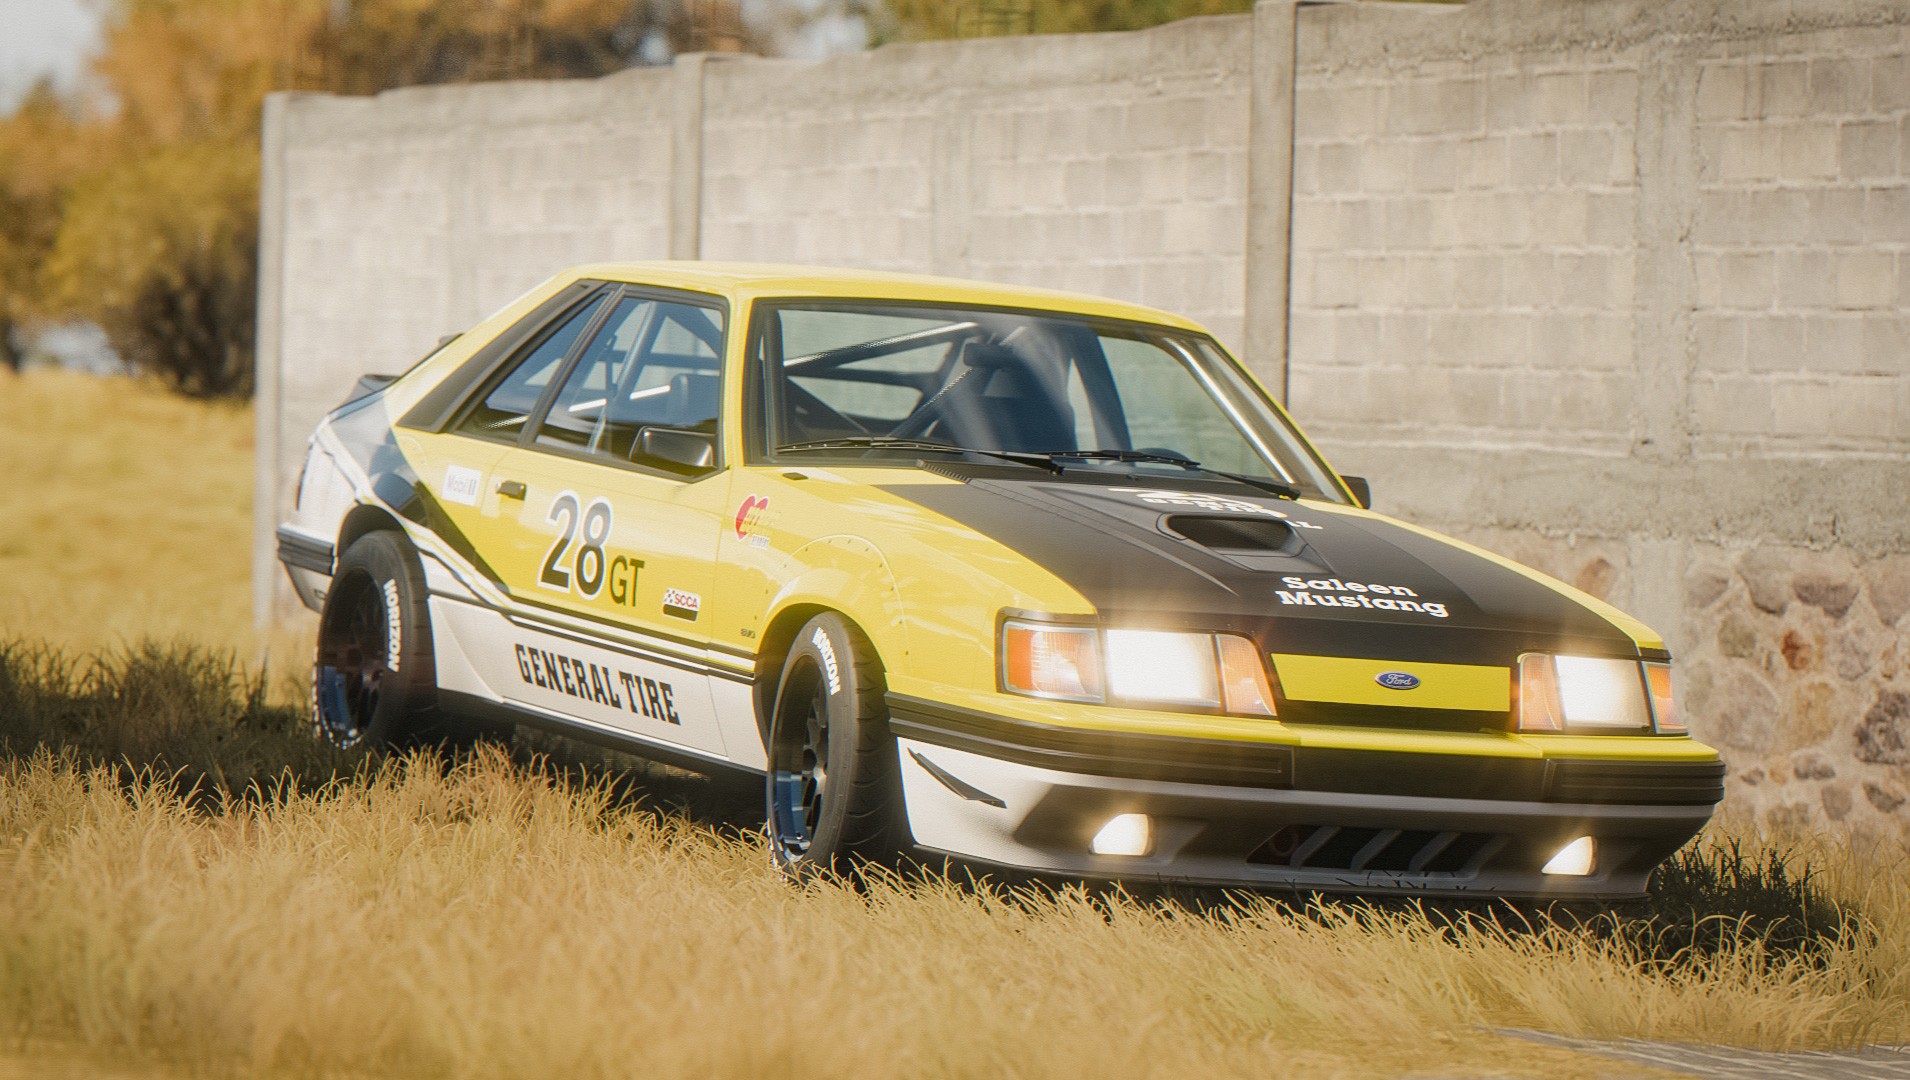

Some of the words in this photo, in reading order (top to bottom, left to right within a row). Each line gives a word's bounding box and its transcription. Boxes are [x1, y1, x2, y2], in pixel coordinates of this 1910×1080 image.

[538, 490, 612, 600] 28
[609, 555, 645, 607] GT
[674, 593, 698, 609] SCCA
[1274, 590, 1449, 618] Mustang
[1281, 576, 1419, 597] Saleen
[384, 579, 401, 672] HORIZON
[514, 643, 623, 710] GENERAL
[618, 670, 681, 726] TIRE
[812, 627, 841, 696] HORIZON
[1386, 673, 1412, 685] Ford
